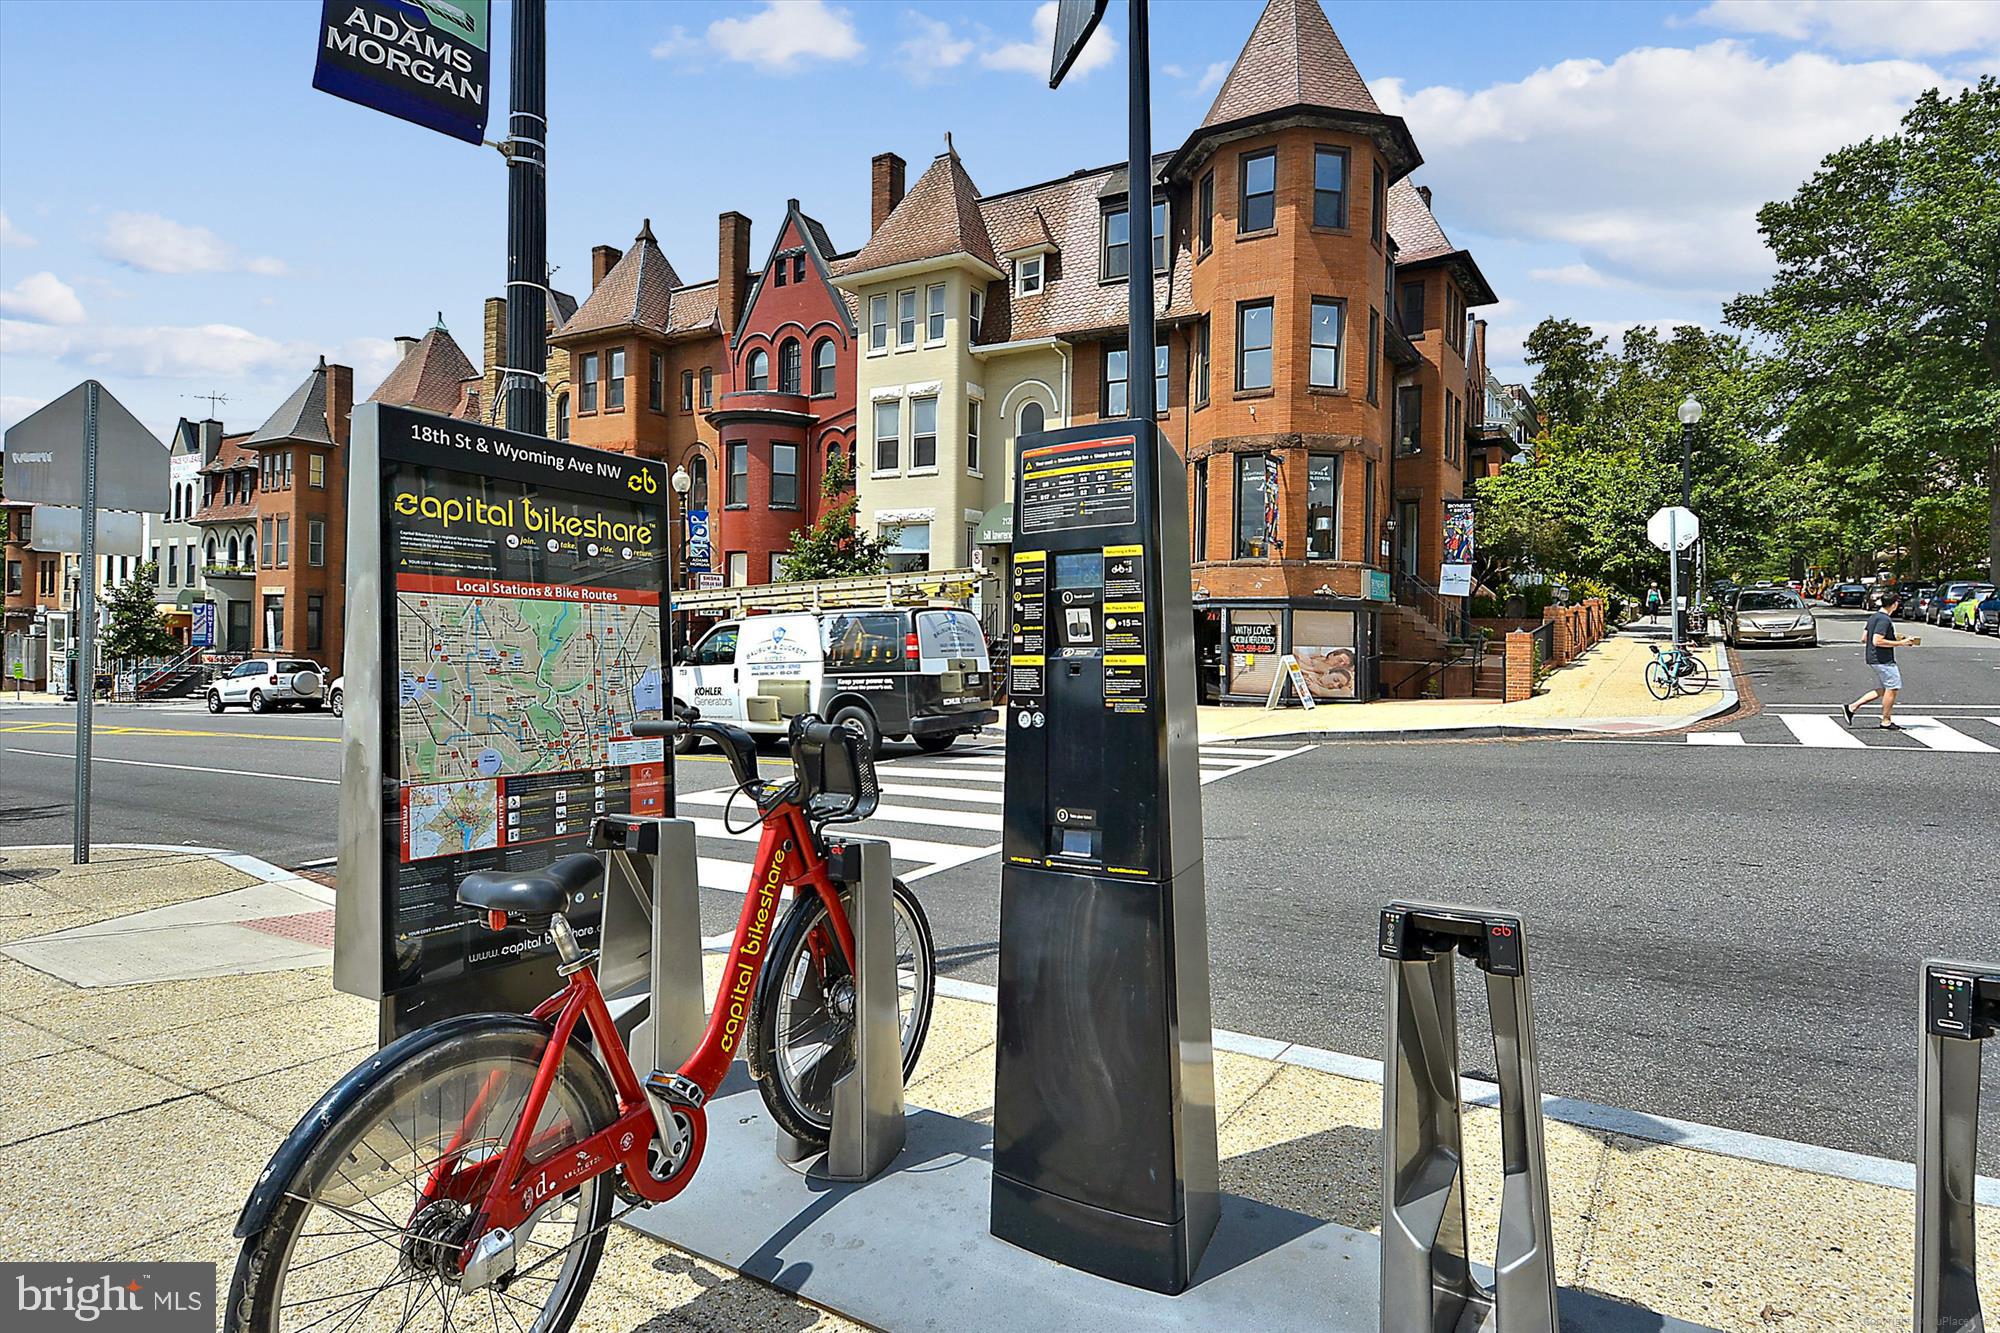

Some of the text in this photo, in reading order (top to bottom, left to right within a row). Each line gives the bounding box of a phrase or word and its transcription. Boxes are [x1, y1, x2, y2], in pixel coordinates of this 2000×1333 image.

[344, 6, 473, 73] ADAMS
[326, 25, 483, 105] MORGAN
[411, 424, 450, 446] 18th
[455, 434, 472, 450] St
[476, 439, 489, 453] &
[494, 441, 564, 470] Wyoming
[568, 458, 593, 475] Ave
[597, 463, 621, 479] NW
[394, 492, 515, 527] capital
[521, 497, 653, 545] bikeshare
[520, 536, 536, 545] join.
[560, 542, 577, 550] take.
[456, 580, 618, 602] Local Stations & Bike Routes
[1234, 625, 1272, 635] WITH LOVE
[694, 686, 722, 696] KOHLER
[694, 696, 732, 706] Generators
[721, 849, 786, 1053] capital bikeshare
